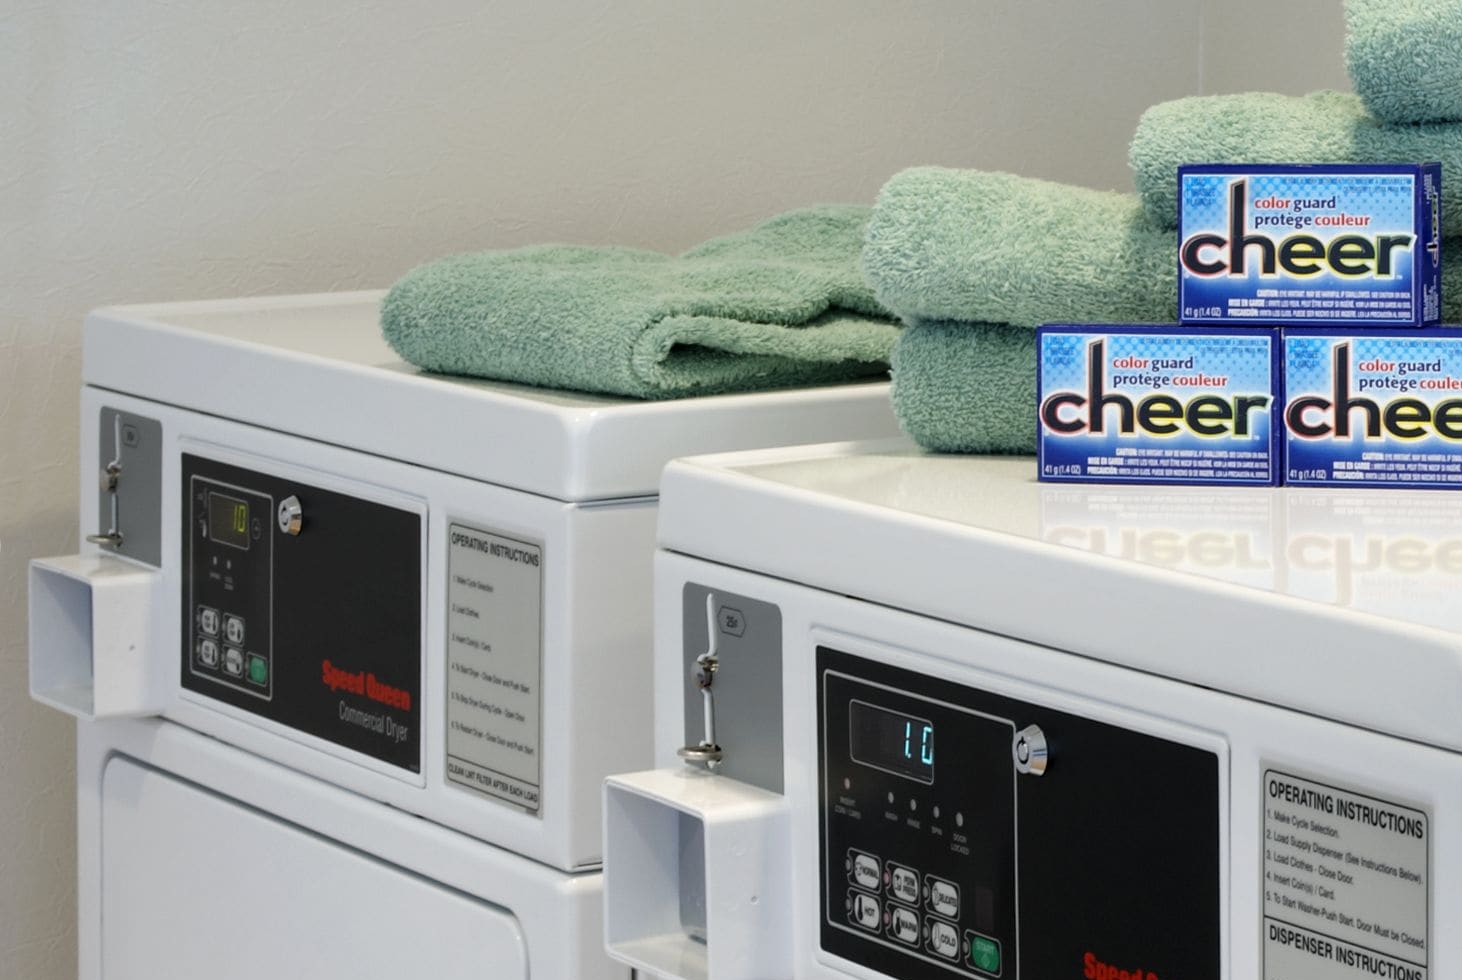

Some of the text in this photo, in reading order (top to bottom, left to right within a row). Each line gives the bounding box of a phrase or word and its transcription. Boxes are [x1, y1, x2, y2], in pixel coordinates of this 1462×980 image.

[1255, 196, 1336, 213] color guard
[1255, 211, 1370, 229] protège couleur
[1182, 180, 1414, 278] cheer
[1113, 356, 1194, 371] color guard
[1359, 358, 1441, 375] color guard
[1041, 338, 1272, 438] cheer
[1113, 372, 1228, 388] protège couleur
[1359, 375, 1417, 392] protège
[452, 532, 539, 567] OPERATING INSTRUCTIONS
[322, 658, 364, 698] Speed
[366, 671, 410, 712] Queen
[339, 699, 407, 745] Commercial Dryer
[1270, 779, 1423, 840] OPERATING INSTRUCTIONS
[1273, 830, 1289, 846] Load
[1290, 835, 1311, 853] Supply
[1312, 842, 1343, 863] Dispenser
[1360, 855, 1397, 877] Instructions
[1273, 850, 1289, 866] Load
[1290, 855, 1313, 873] Clothes
[1318, 864, 1335, 880] Close
[864, 905, 875, 919] HOT
[1273, 891, 1280, 905] To
[1282, 894, 1296, 910] Start
[1356, 917, 1372, 933] Door
[1373, 922, 1389, 939] Must
[1391, 928, 1399, 942] be
[941, 933, 955, 948] COLD
[1270, 924, 1332, 960] DISPENSER
